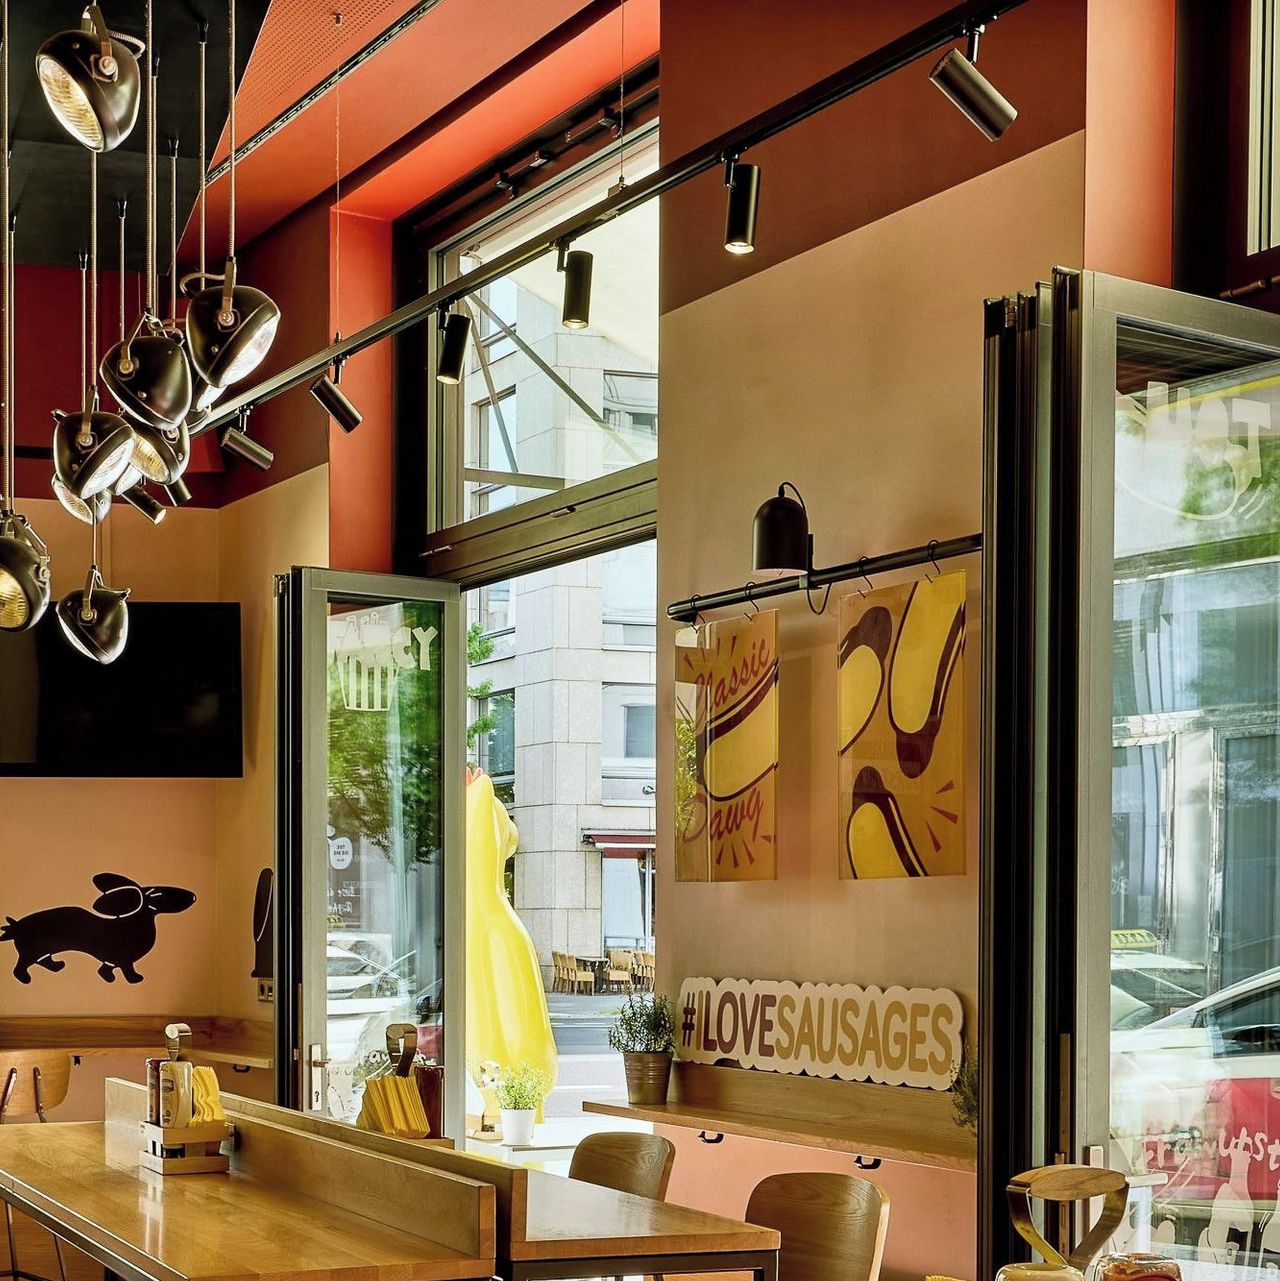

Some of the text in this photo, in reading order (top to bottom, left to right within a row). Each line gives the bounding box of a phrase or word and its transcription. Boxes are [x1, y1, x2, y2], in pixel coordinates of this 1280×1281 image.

[1146, 381, 1272, 478] HOT
[694, 638, 771, 722] Classic
[682, 786, 765, 843] Dawg
[681, 990, 954, 1076] #ILOVESAUSAGES
